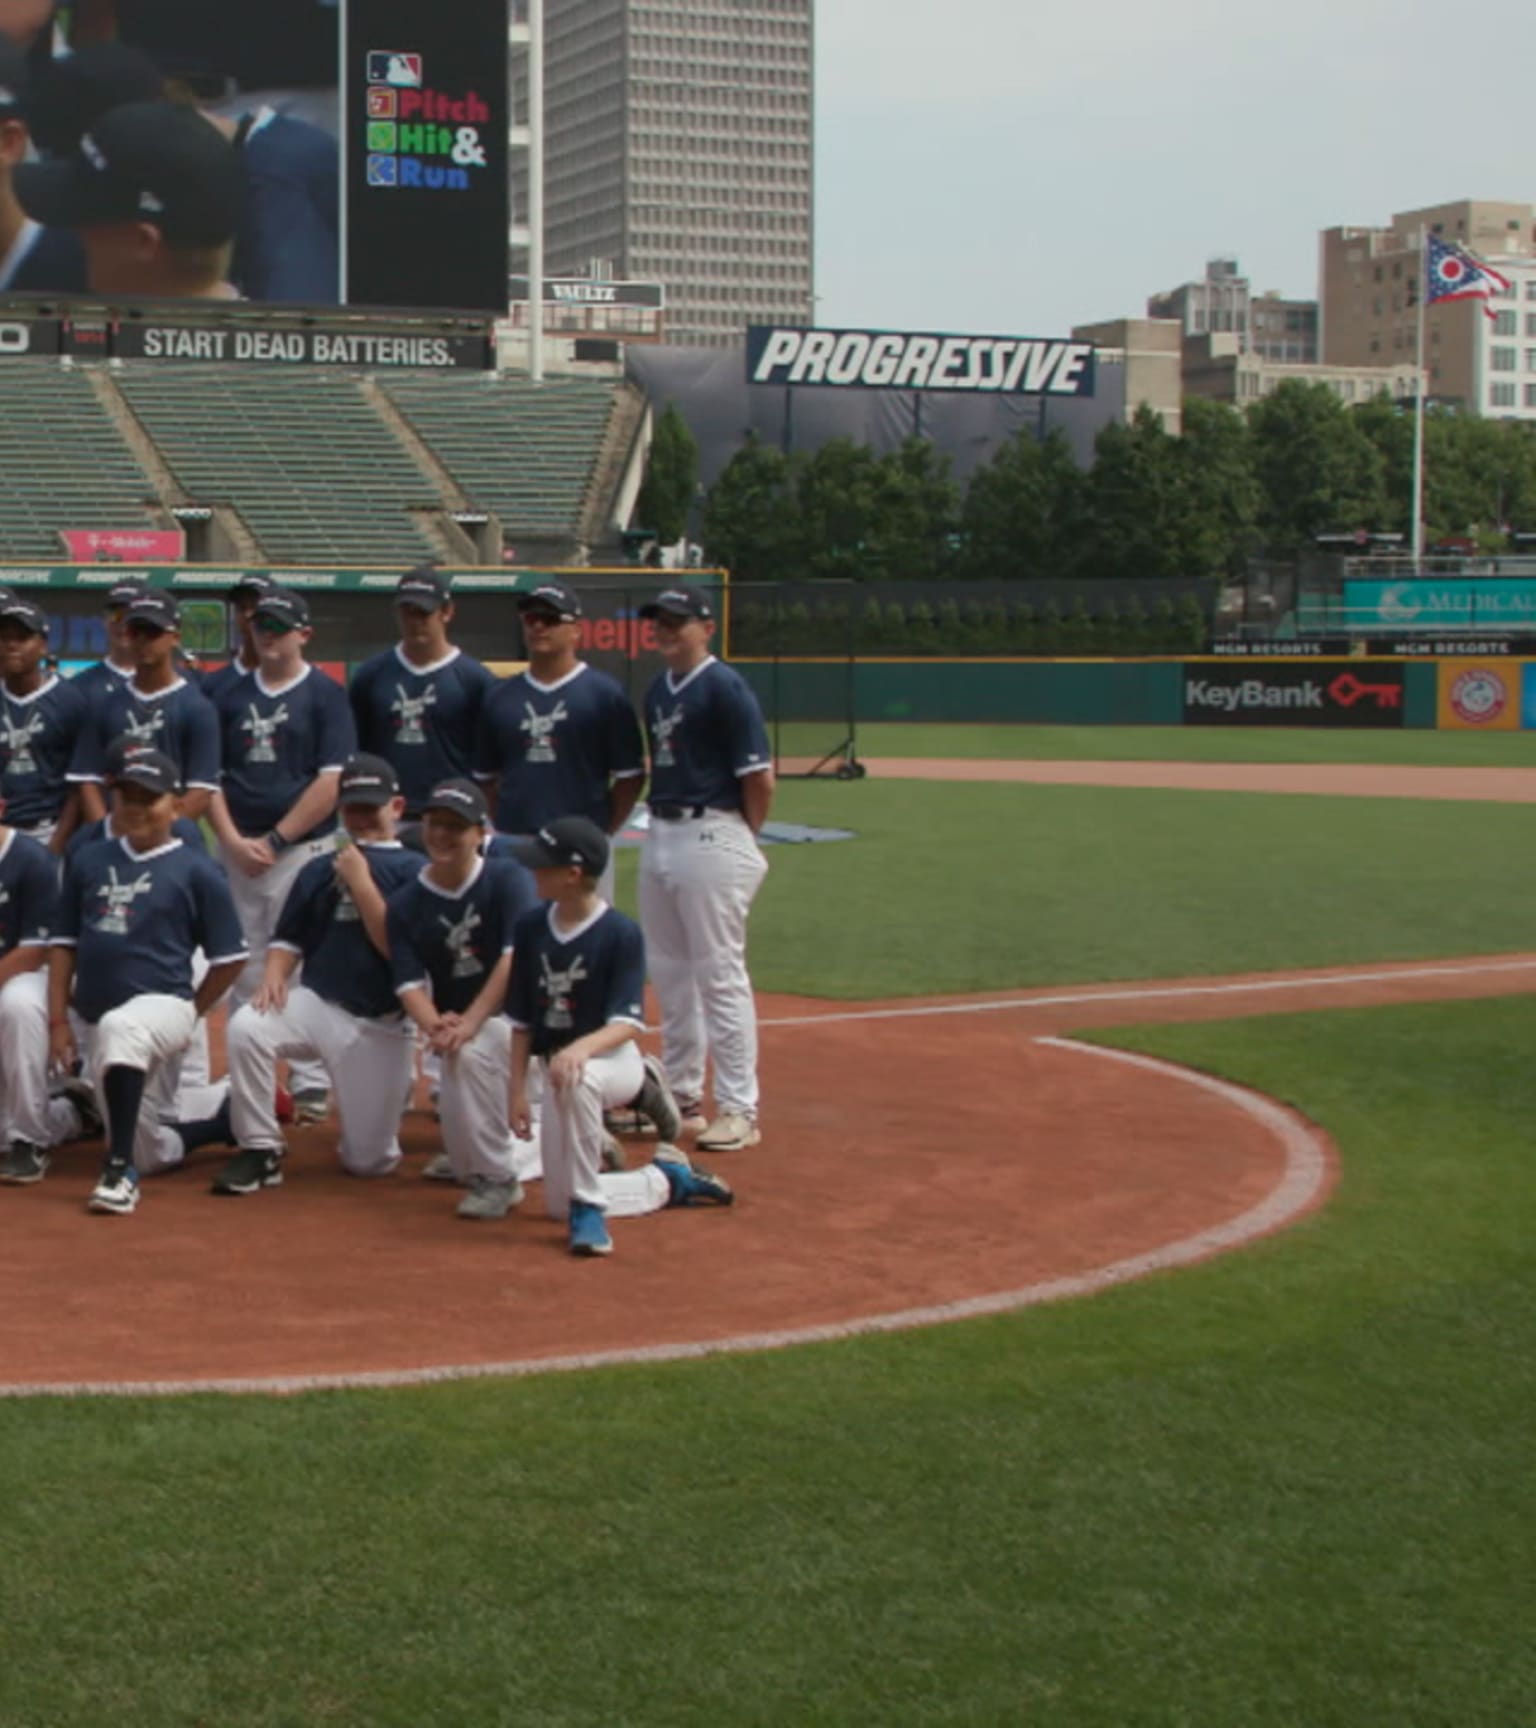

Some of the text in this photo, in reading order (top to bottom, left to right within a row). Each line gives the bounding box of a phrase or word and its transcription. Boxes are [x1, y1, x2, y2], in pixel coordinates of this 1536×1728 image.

[400, 87, 490, 123] Pitch
[400, 123, 487, 167] Hit &
[400, 157, 469, 190] Run
[144, 328, 457, 366] START DEAD BATTERIES.
[753, 329, 1092, 393] PROGRESSIVE
[1186, 680, 1324, 711] KeyBank
